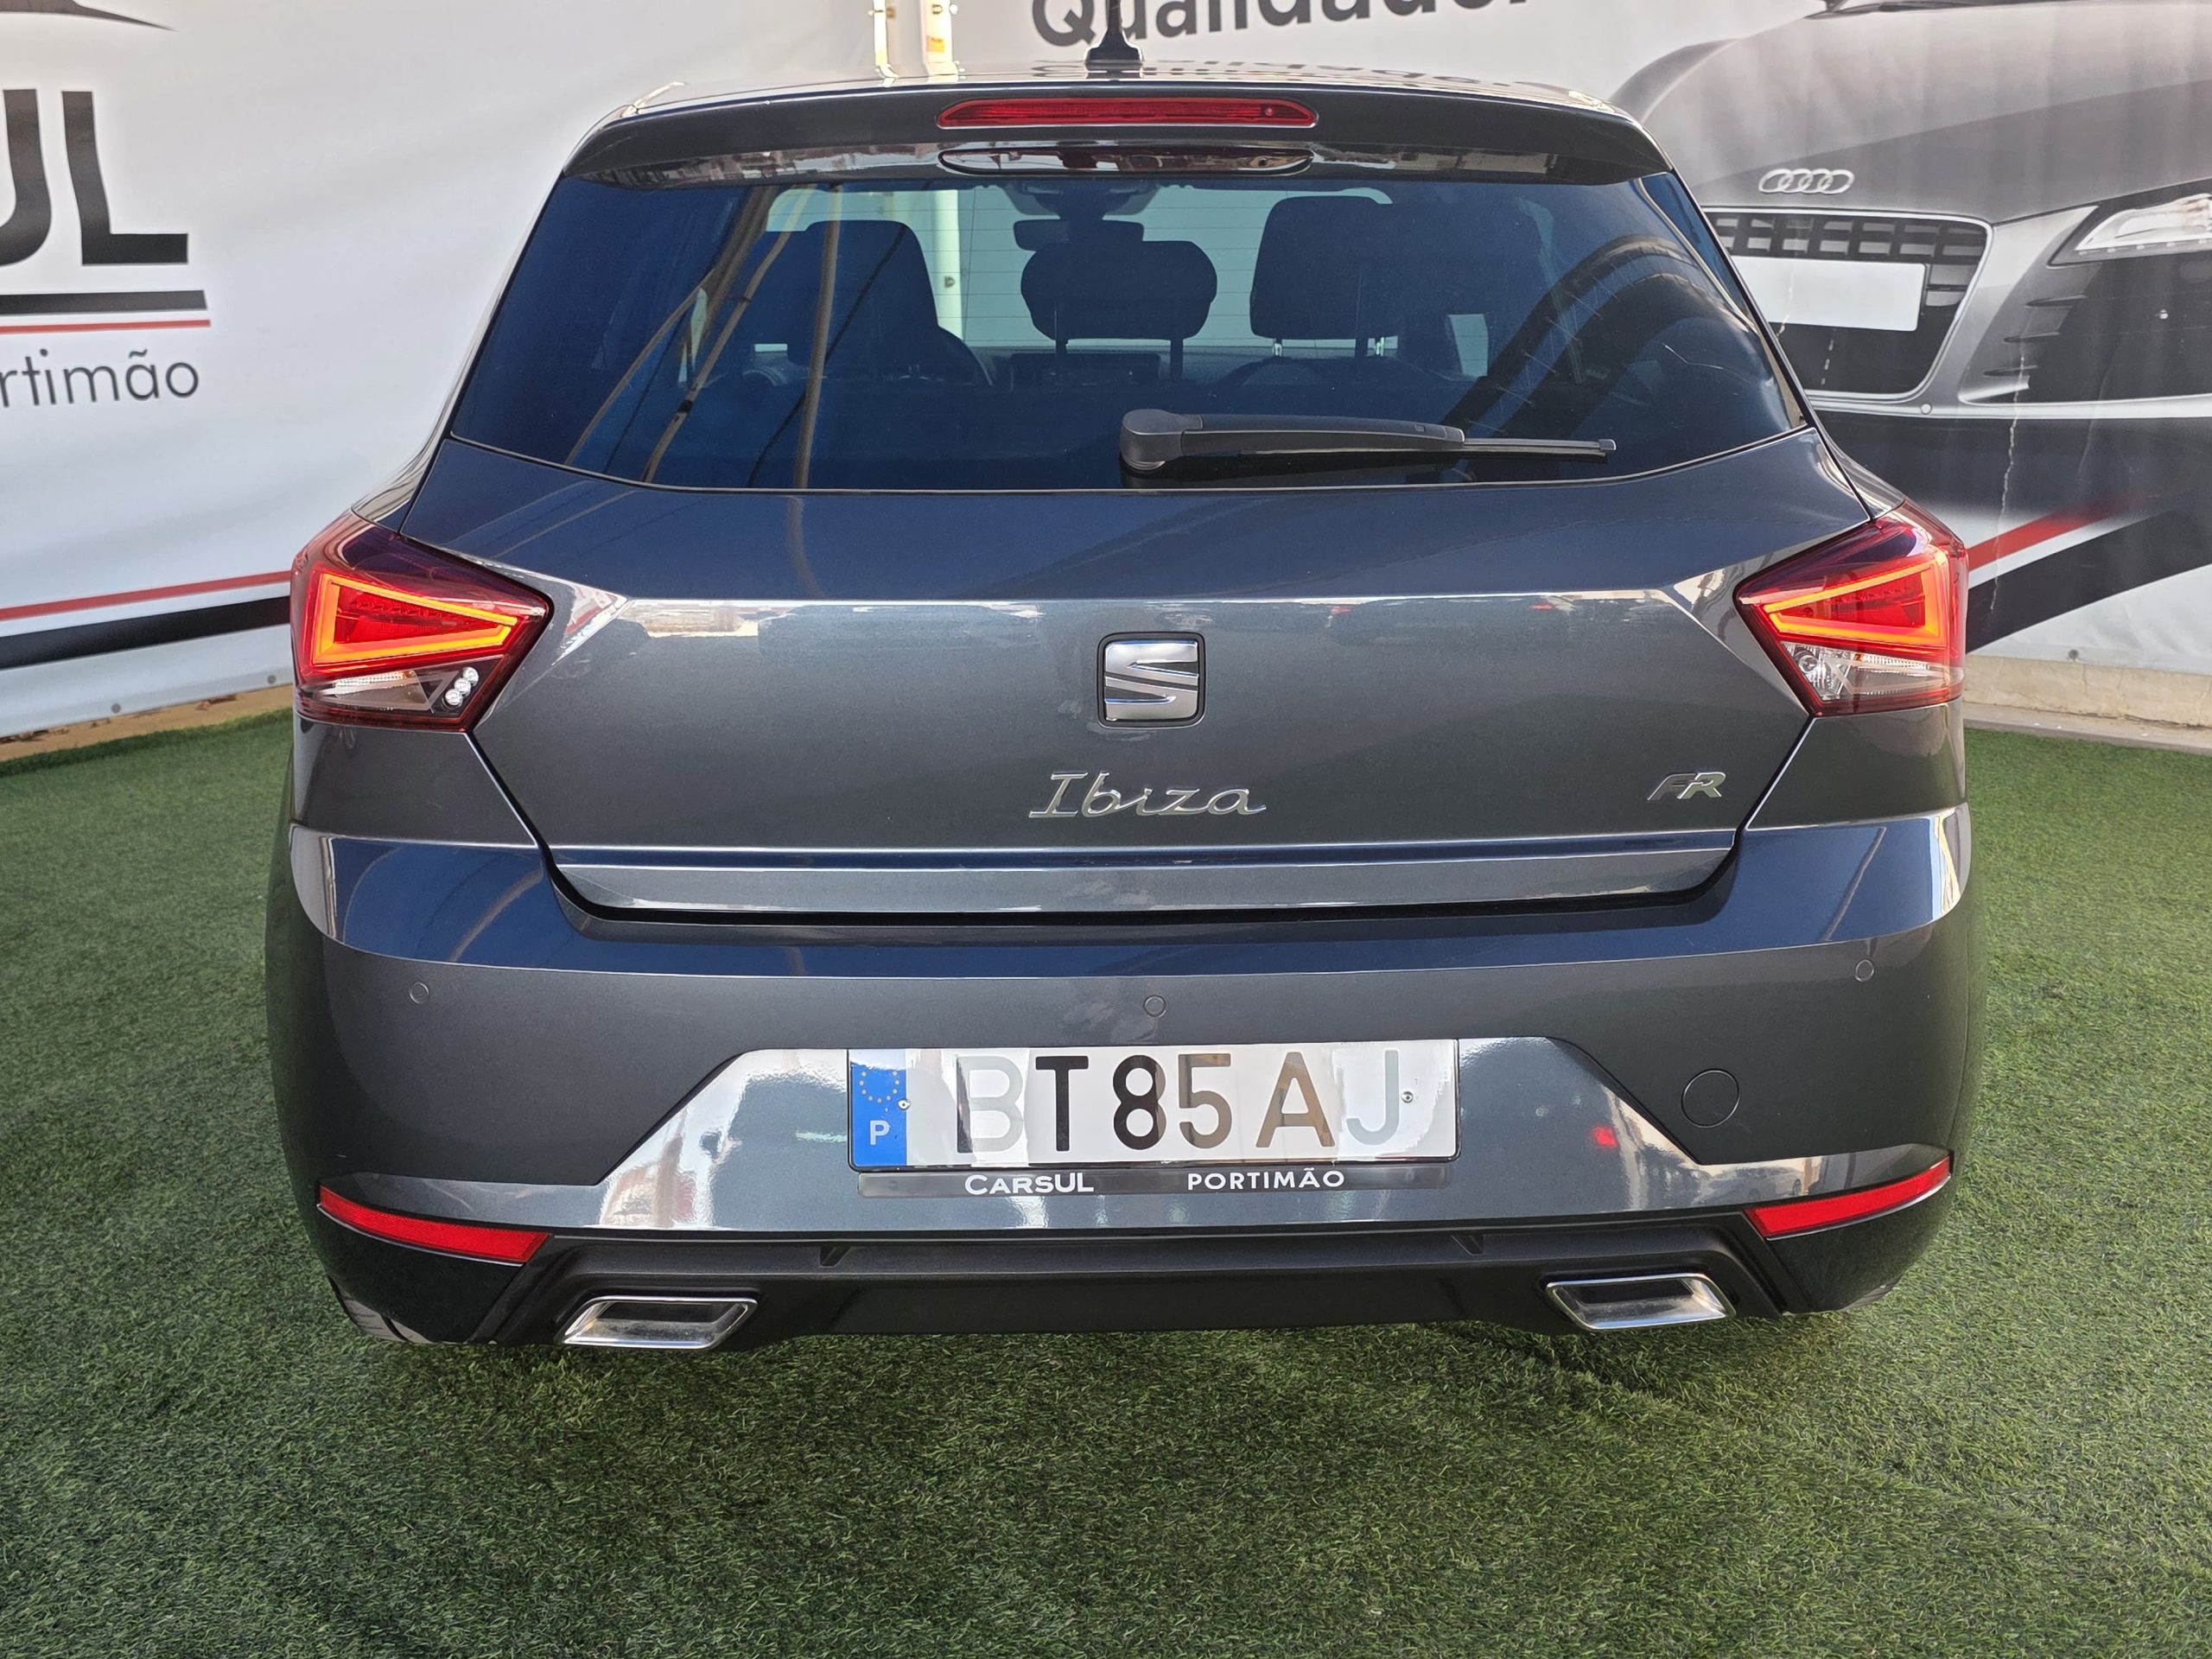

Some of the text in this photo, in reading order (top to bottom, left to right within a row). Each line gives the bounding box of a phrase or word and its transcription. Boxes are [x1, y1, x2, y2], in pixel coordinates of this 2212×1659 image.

[0, 348, 200, 408] rtimão
[1028, 771, 1267, 818] Ibiza
[1647, 772, 1726, 801] FR
[869, 1120, 892, 1146] P
[965, 1167, 1344, 1195] CARSUL PORTIMÃO
